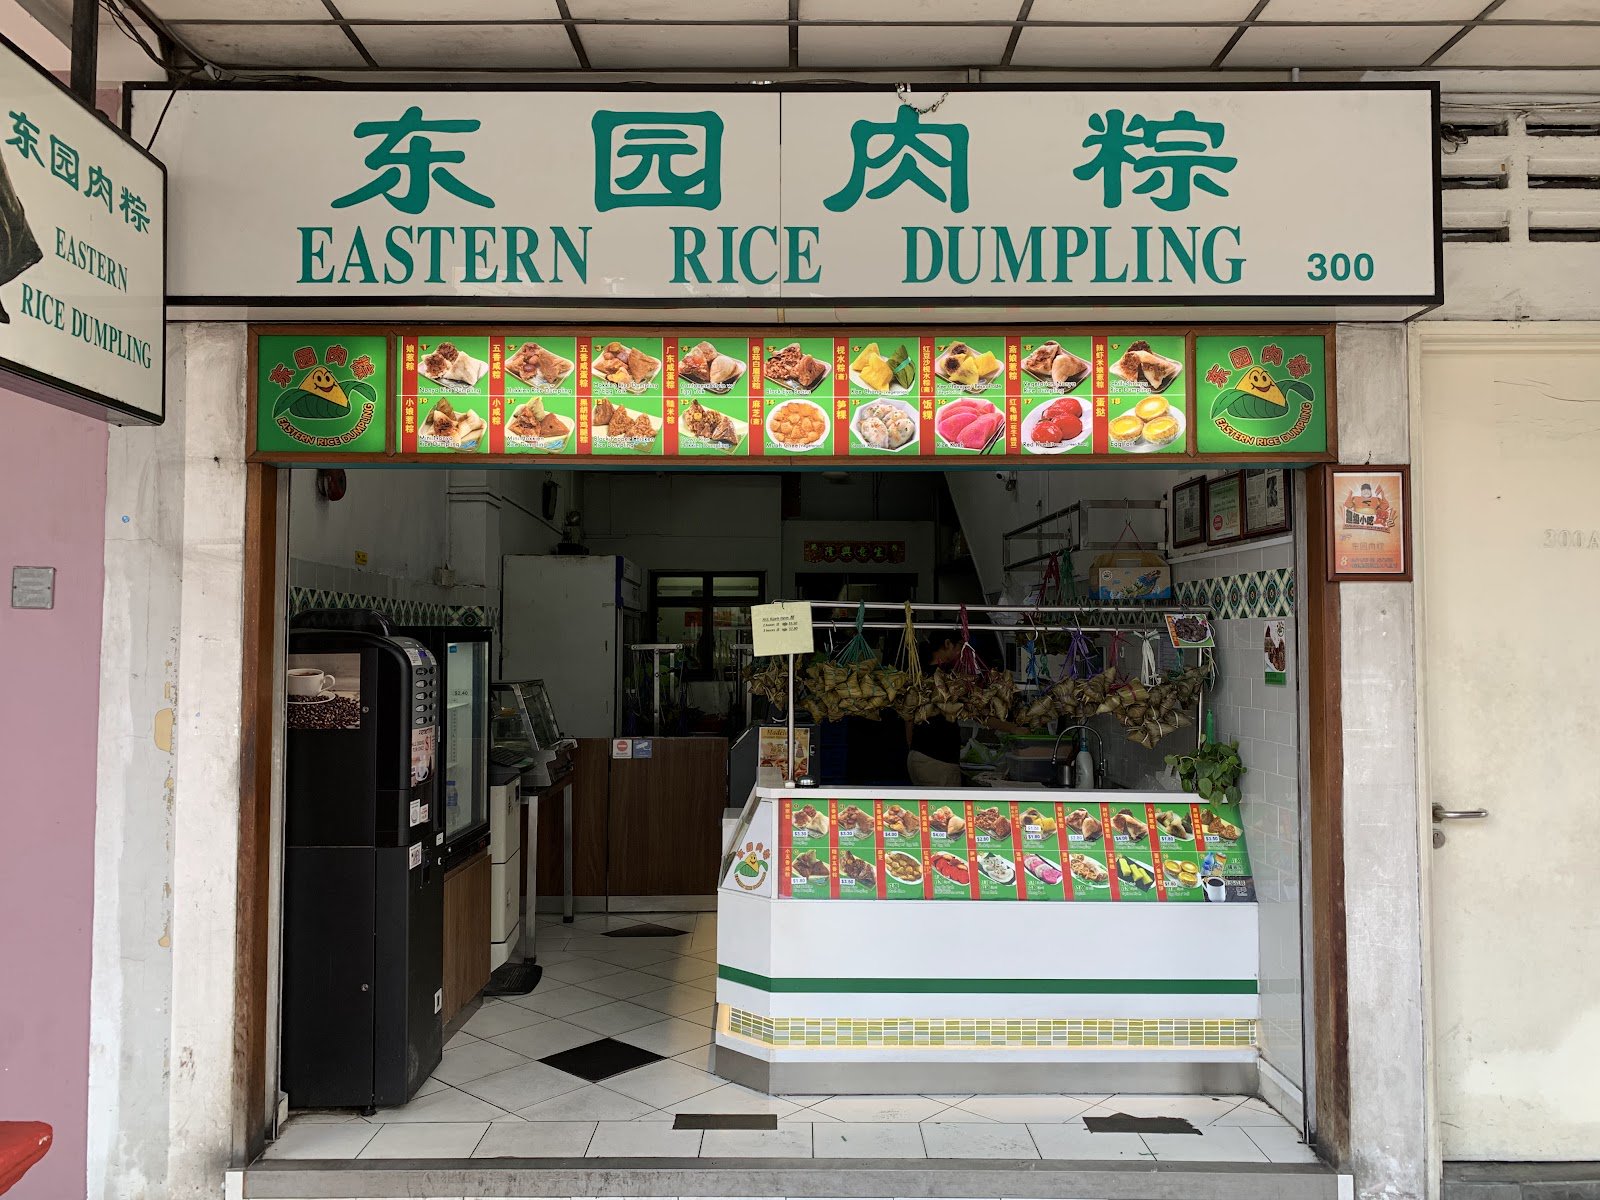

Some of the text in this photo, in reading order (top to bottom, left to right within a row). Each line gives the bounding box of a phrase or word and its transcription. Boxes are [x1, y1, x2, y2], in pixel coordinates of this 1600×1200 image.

[7, 111, 150, 234] 东园肉粽
[332, 104, 1237, 214] 东园肉粽
[56, 226, 128, 293] EASTERN
[300, 226, 1244, 284] EASTERN RICE DUMPLING
[1307, 252, 1375, 282] 300
[21, 283, 152, 369] RICE DUMPLING
[277, 402, 374, 446] EASTERN RICE DUMPLING
[1215, 402, 1312, 446] EASTERN RICE DUMPLING
